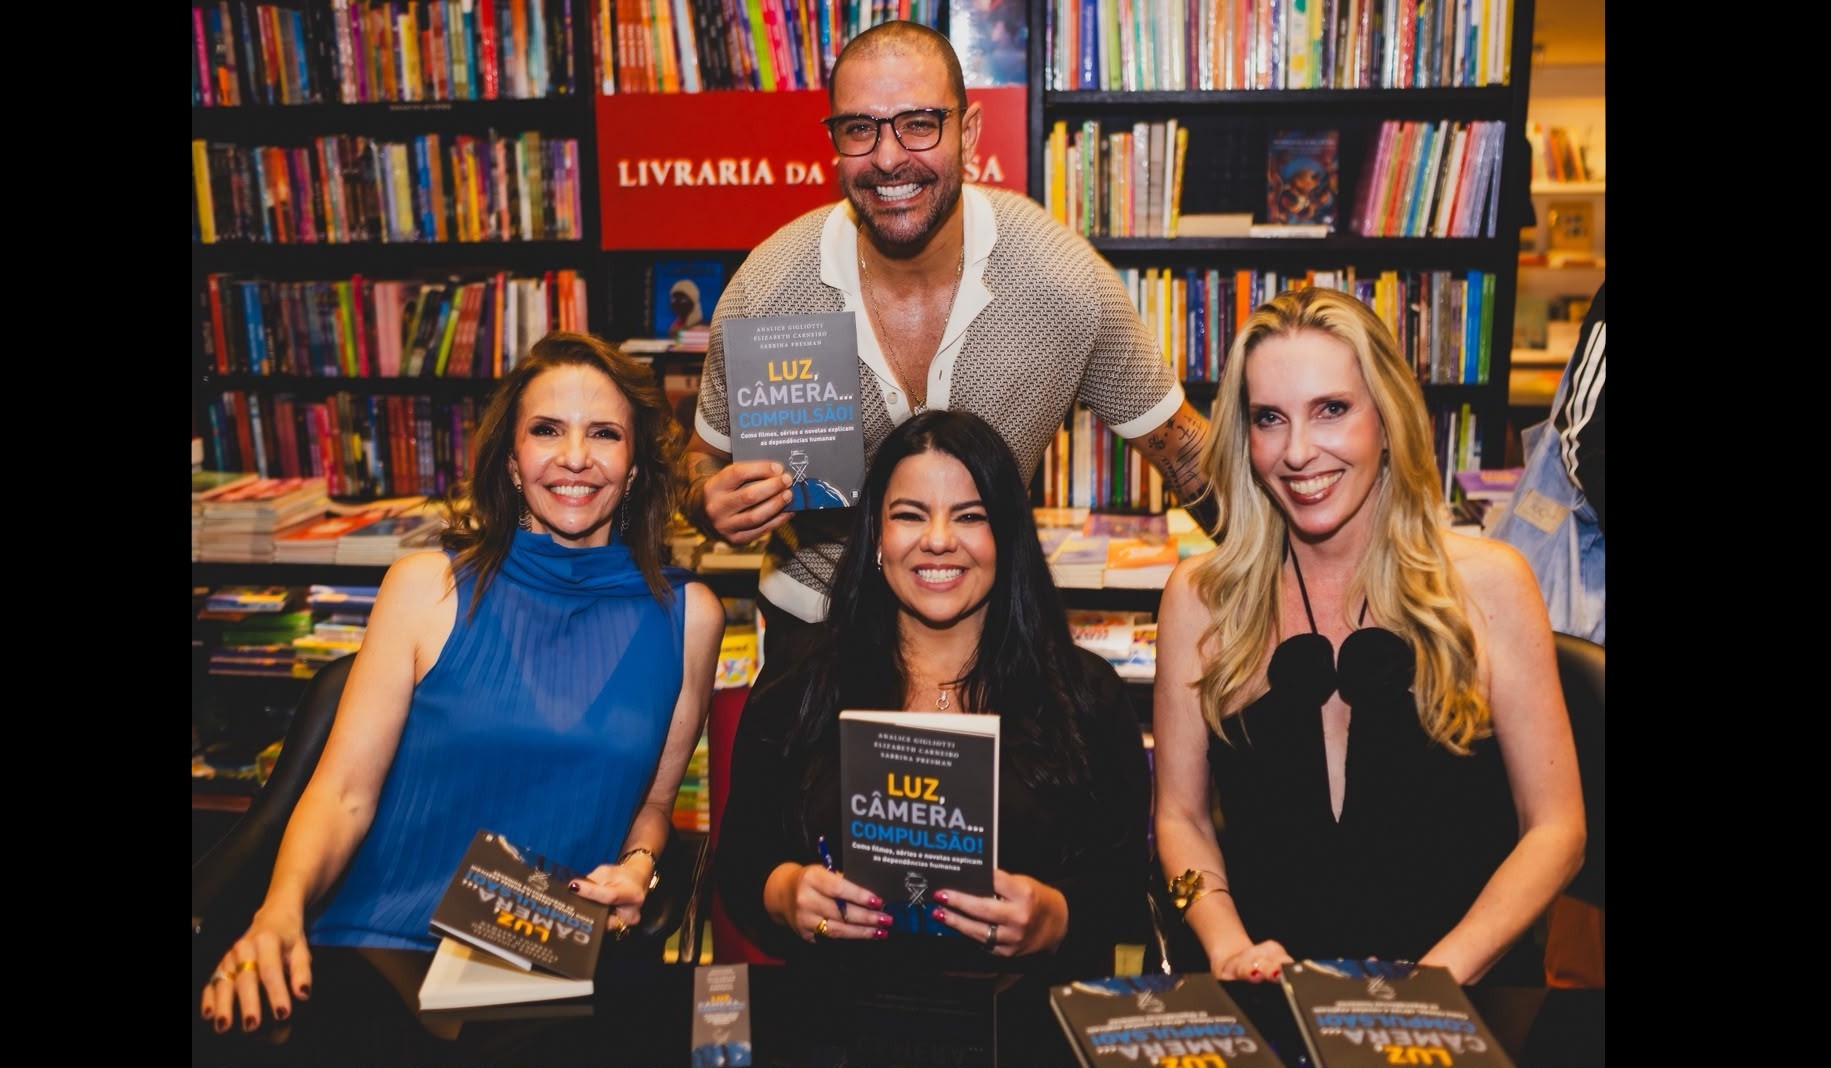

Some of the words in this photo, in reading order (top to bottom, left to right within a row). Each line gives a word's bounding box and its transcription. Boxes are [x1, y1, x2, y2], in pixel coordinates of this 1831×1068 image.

[618, 158, 776, 187] LIVRARIA
[785, 162, 824, 185] DA
[753, 332, 790, 341] ELIZABETH
[793, 331, 827, 339] CARNEIRO
[788, 323, 823, 331] GIGLIOTTI
[760, 341, 789, 349] SABRINA
[768, 359, 818, 382] LUZ,
[737, 380, 853, 407] CÂMERA...
[738, 404, 853, 428] COMPULSÃO!
[758, 430, 780, 438] filmes,
[780, 429, 798, 437] séries
[828, 426, 854, 434] explicam
[769, 437, 808, 446] dependências
[810, 435, 836, 443] humanas
[888, 773, 946, 806] LUZ,
[852, 791, 984, 832] CÂMERA...
[851, 820, 983, 853] COMPULSÃO!
[852, 842, 870, 851] Como
[872, 844, 894, 855] filmes,
[896, 848, 917, 859] séries
[924, 852, 950, 862] novelas
[952, 855, 983, 866] explicam
[882, 855, 928, 868] dependências
[930, 862, 960, 871] humanas
[465, 870, 592, 932] COMPULSÃO!
[494, 908, 550, 943] LUZ,
